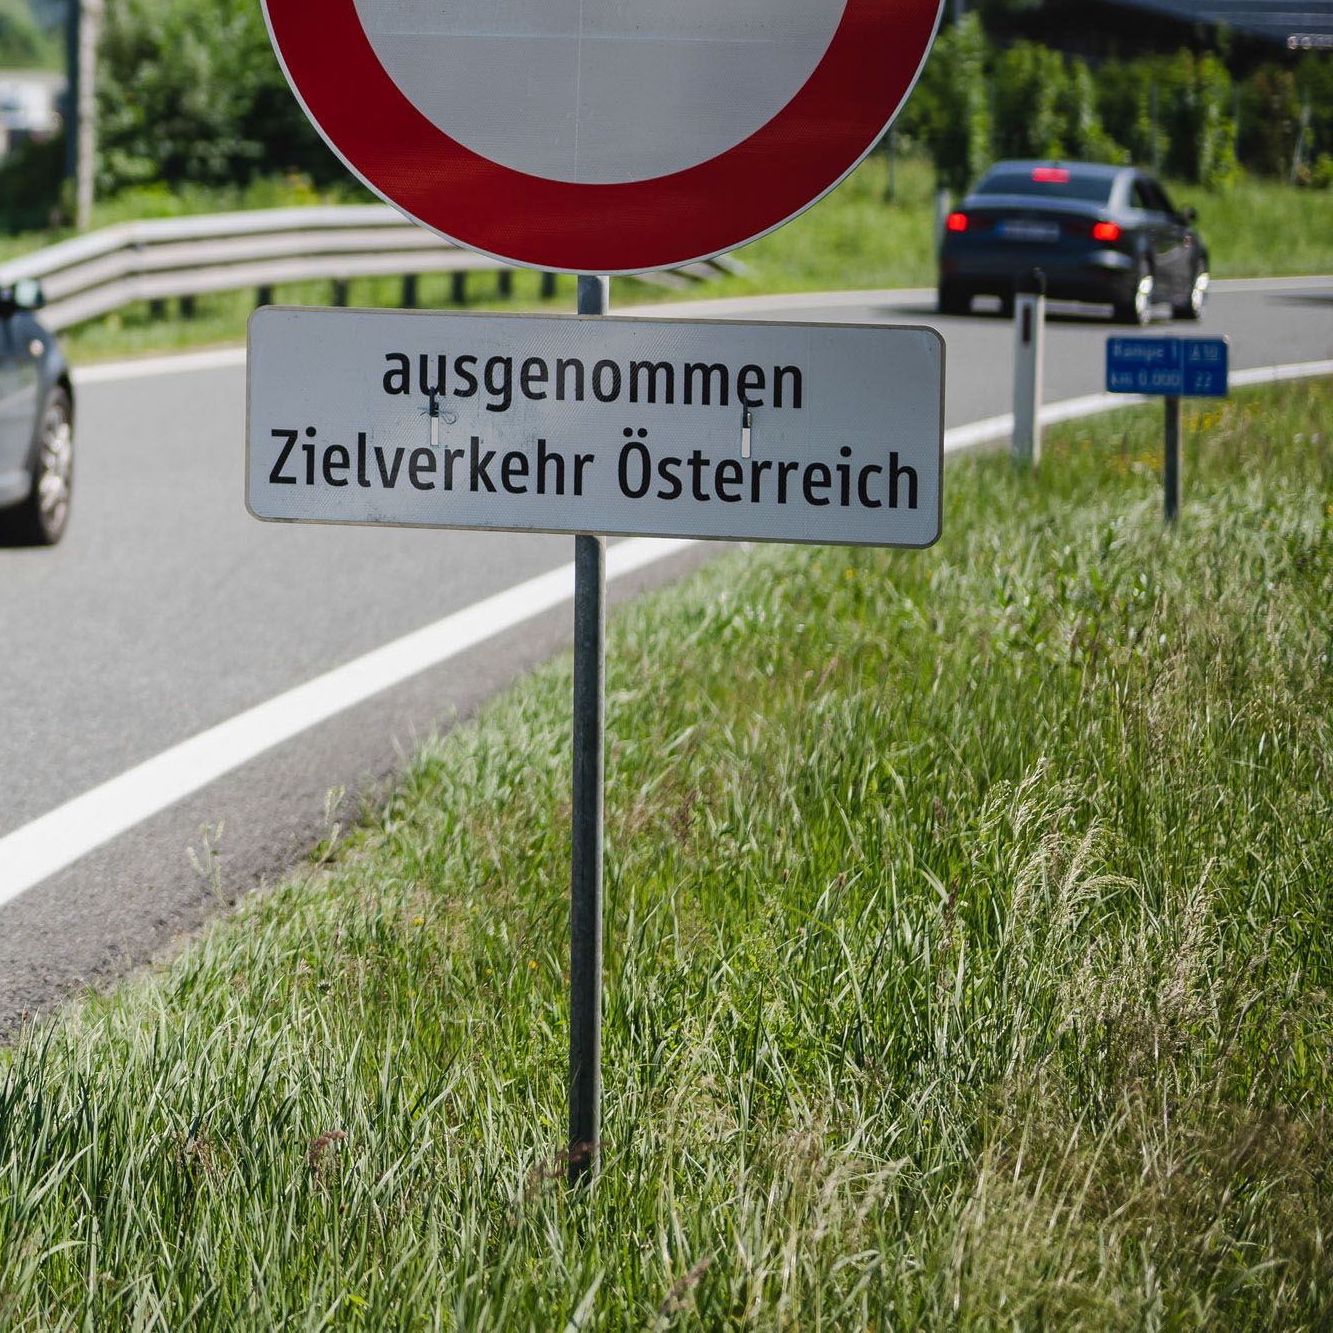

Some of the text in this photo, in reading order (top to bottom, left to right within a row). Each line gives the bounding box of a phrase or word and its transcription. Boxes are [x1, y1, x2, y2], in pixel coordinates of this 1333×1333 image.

[382, 351, 804, 413] ausgenommen
[268, 426, 920, 510] Zielverkehr Österreich
